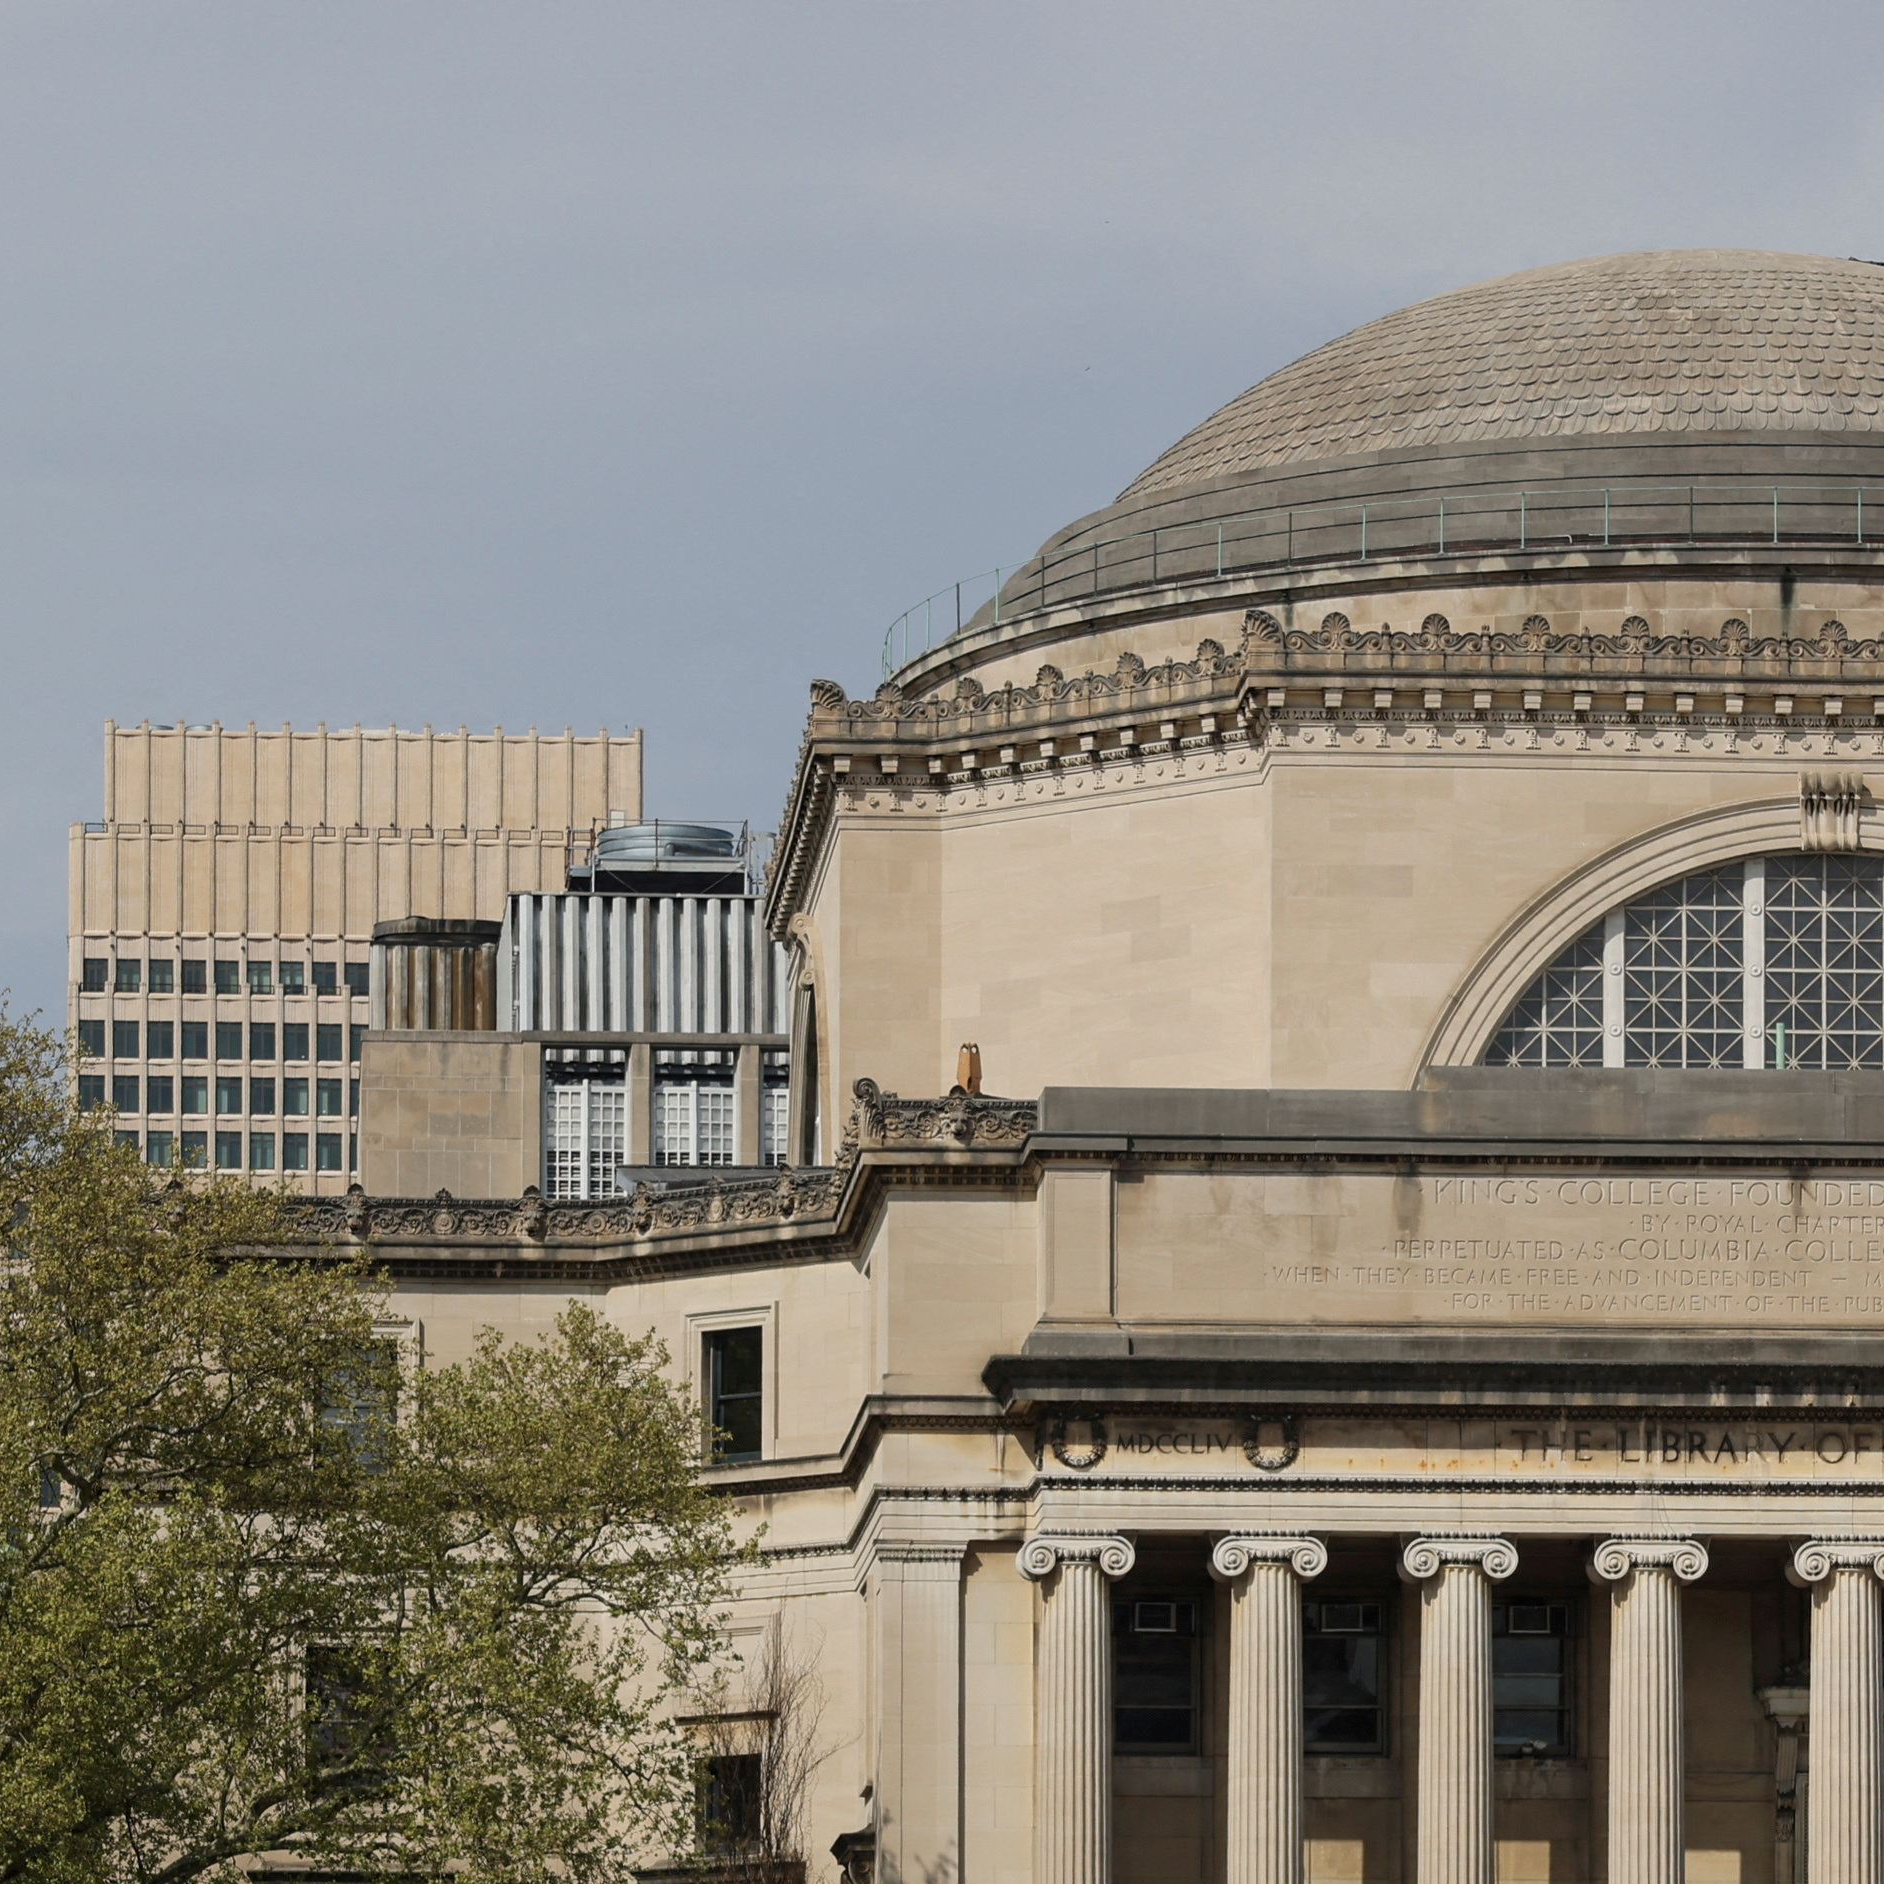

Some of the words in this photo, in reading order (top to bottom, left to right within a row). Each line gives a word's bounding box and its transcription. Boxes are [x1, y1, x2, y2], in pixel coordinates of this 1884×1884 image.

[1434, 1179, 1539, 1205] KING'S
[1558, 1180, 1711, 1207] COLLEGE
[1641, 1213, 1670, 1233] BY
[1685, 1214, 1765, 1233] ROYAL
[1394, 1239, 1564, 1261] PERPETUATED
[1576, 1240, 1605, 1261] AS
[1618, 1238, 1769, 1262] COLUMBIA
[1273, 1266, 1341, 1285] WHEN
[1352, 1266, 1411, 1285] THEY
[1424, 1267, 1514, 1286] BECAME
[1526, 1268, 1580, 1287] FREE
[1591, 1269, 1640, 1287] AND
[1654, 1269, 1813, 1288] INDEPENDENT
[1452, 1293, 1493, 1311] FOR
[1507, 1293, 1552, 1311] THE
[1563, 1293, 1734, 1312] ADVANCEMENT
[1744, 1295, 1776, 1313] OF
[1785, 1296, 1830, 1314] THE
[1115, 1432, 1233, 1455] MDCCLIV
[1510, 1428, 1594, 1462] THE
[1618, 1429, 1797, 1465] LIBRARY
[1816, 1431, 1875, 1465] OF
